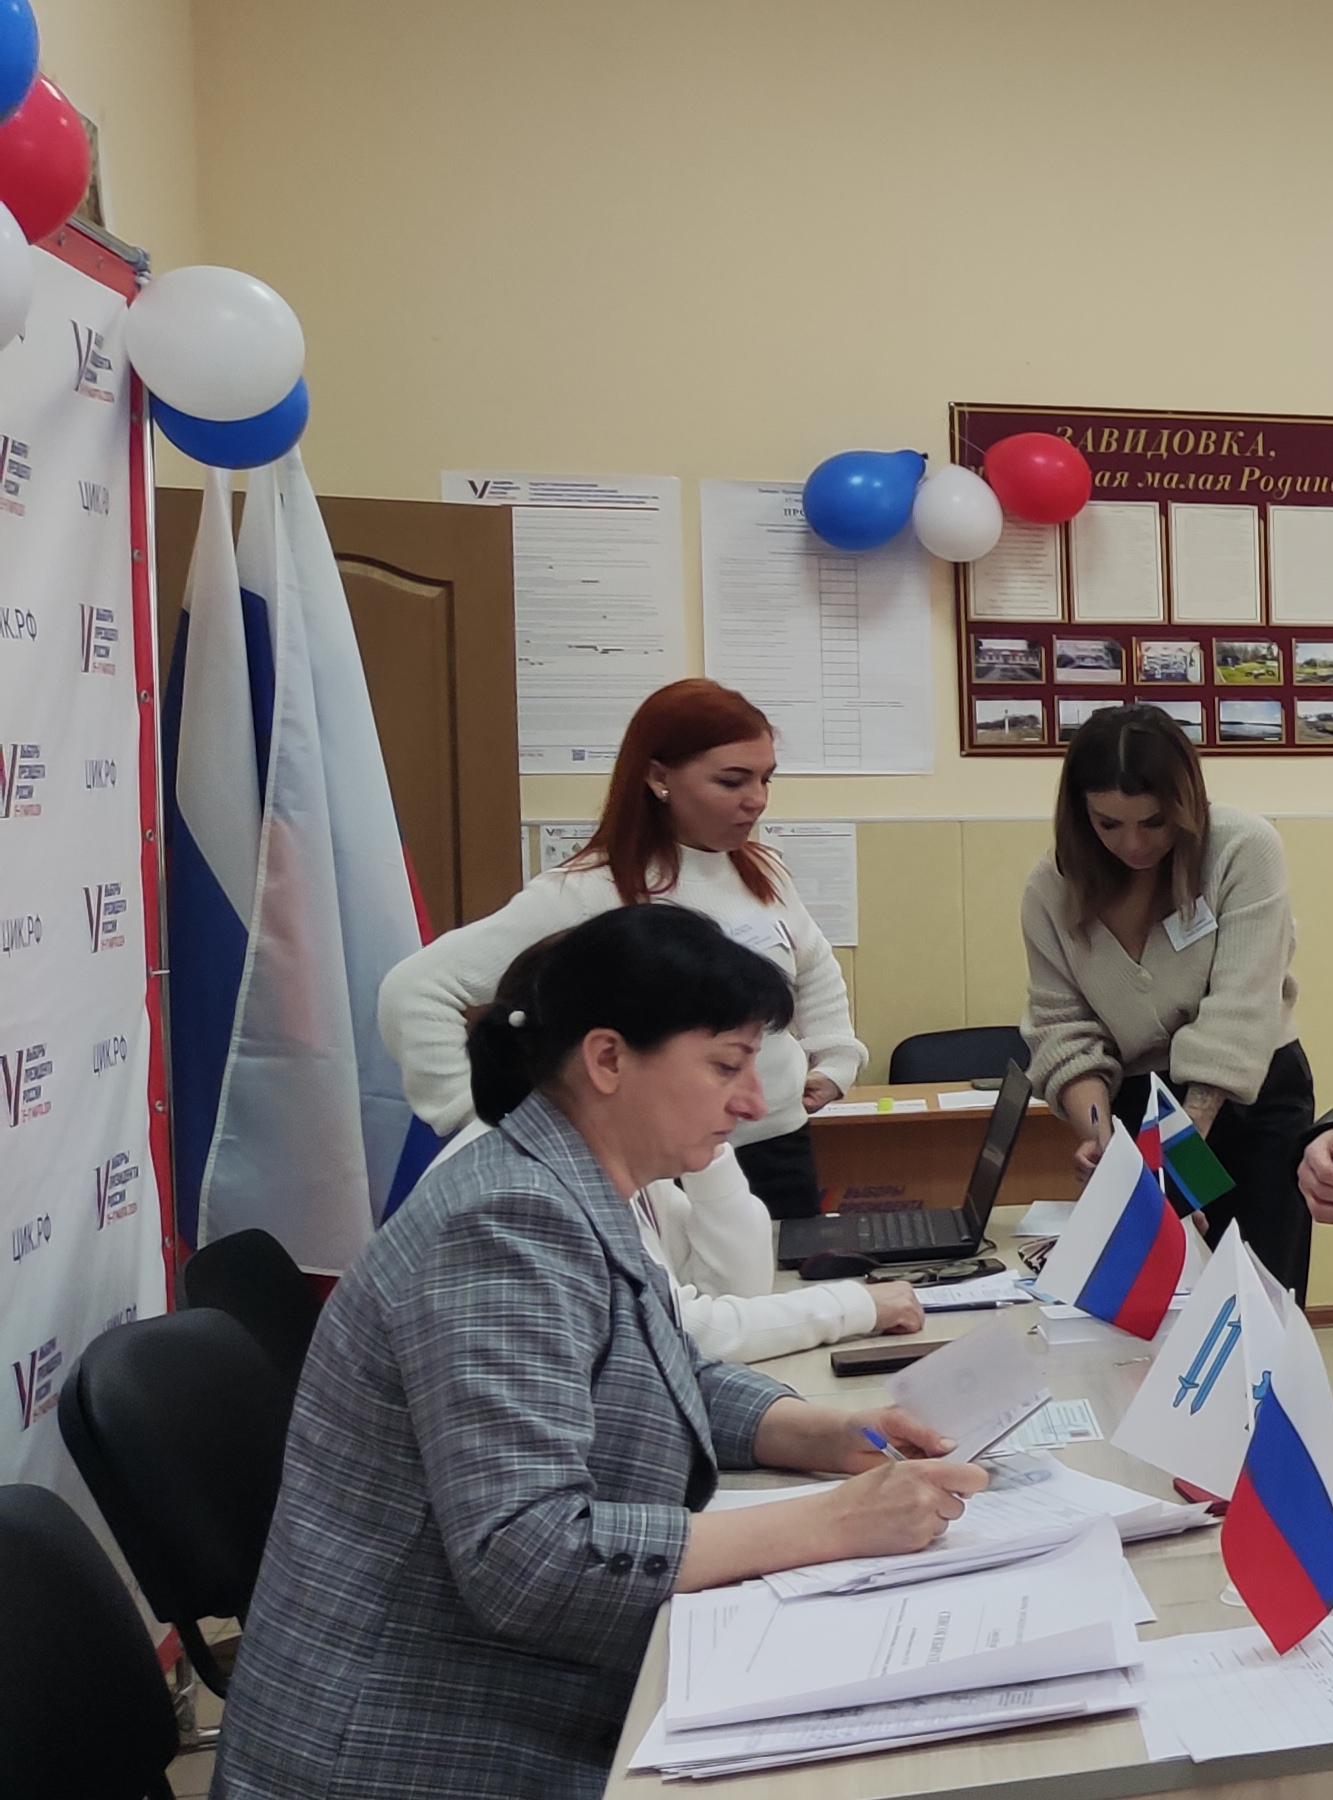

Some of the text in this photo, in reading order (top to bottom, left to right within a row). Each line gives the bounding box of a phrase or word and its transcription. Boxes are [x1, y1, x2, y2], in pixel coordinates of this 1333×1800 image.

[1136, 471, 1232, 491] малая
[85, 759, 117, 793] ЦИК.РФ
[2, 914, 43, 958] ЦИК.РФ
[93, 1034, 128, 1077] ЦИК.РФ
[12, 1212, 52, 1263] ЦИК.РФ
